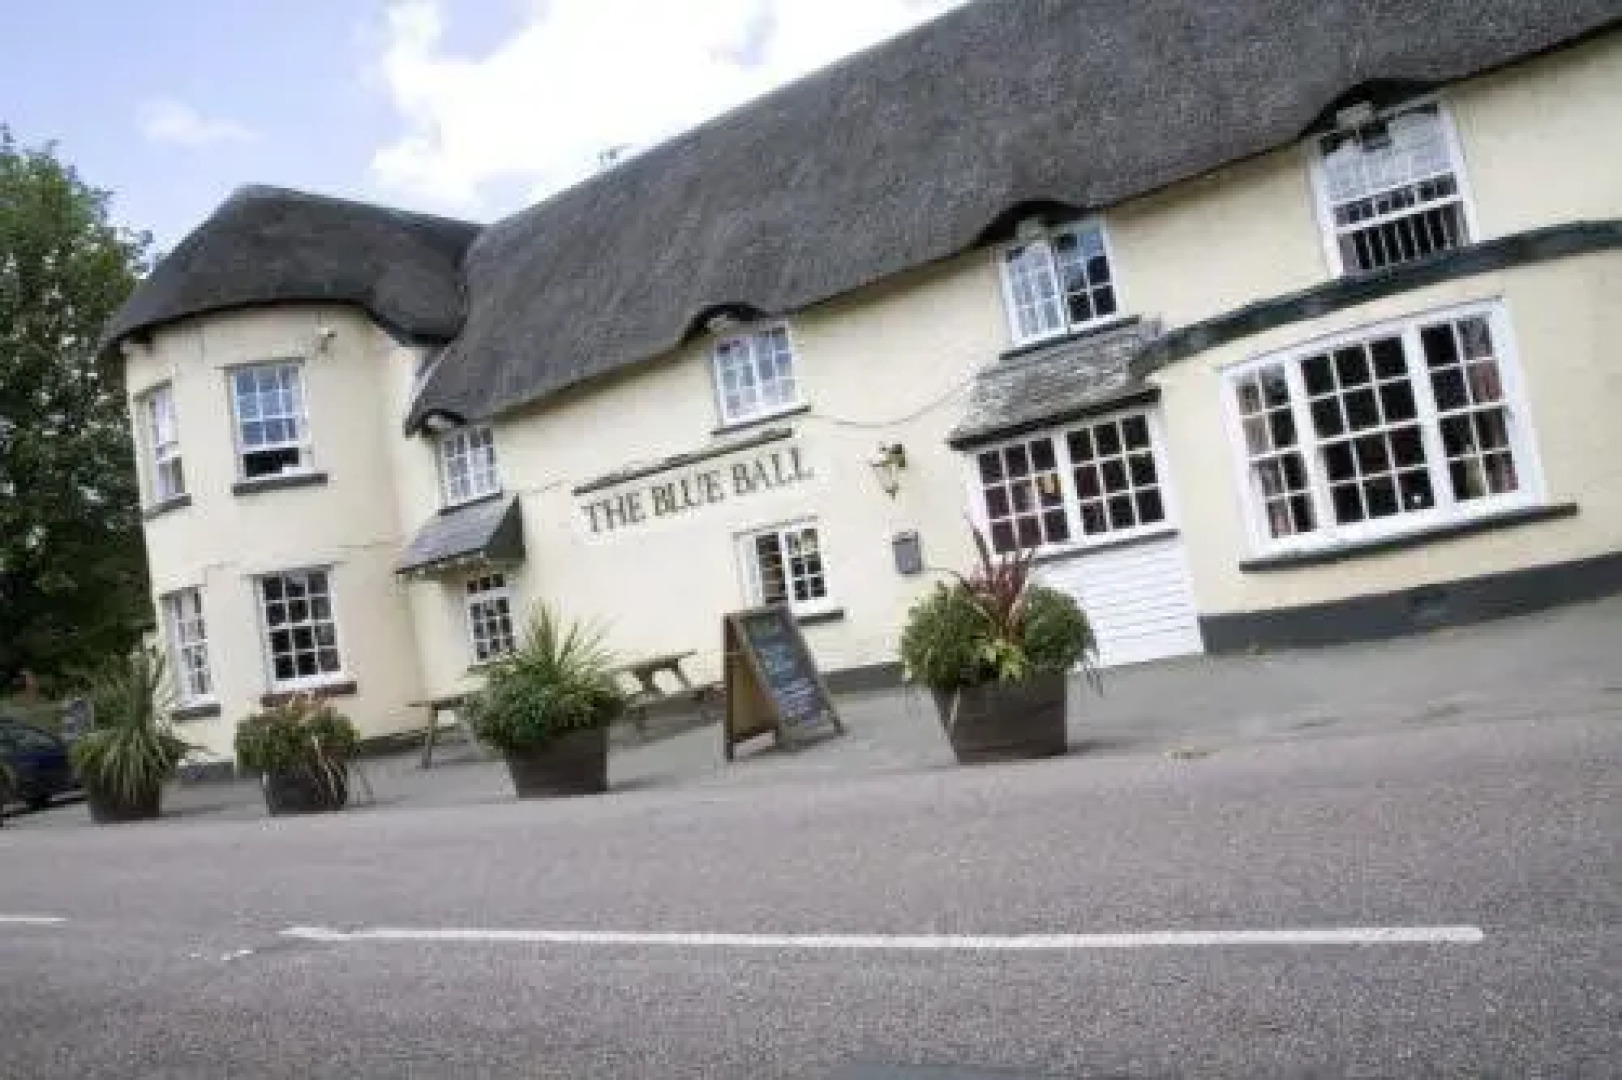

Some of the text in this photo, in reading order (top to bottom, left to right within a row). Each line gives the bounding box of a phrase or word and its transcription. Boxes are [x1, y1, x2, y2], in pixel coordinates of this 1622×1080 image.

[581, 447, 814, 532] THE BLUE BALL
